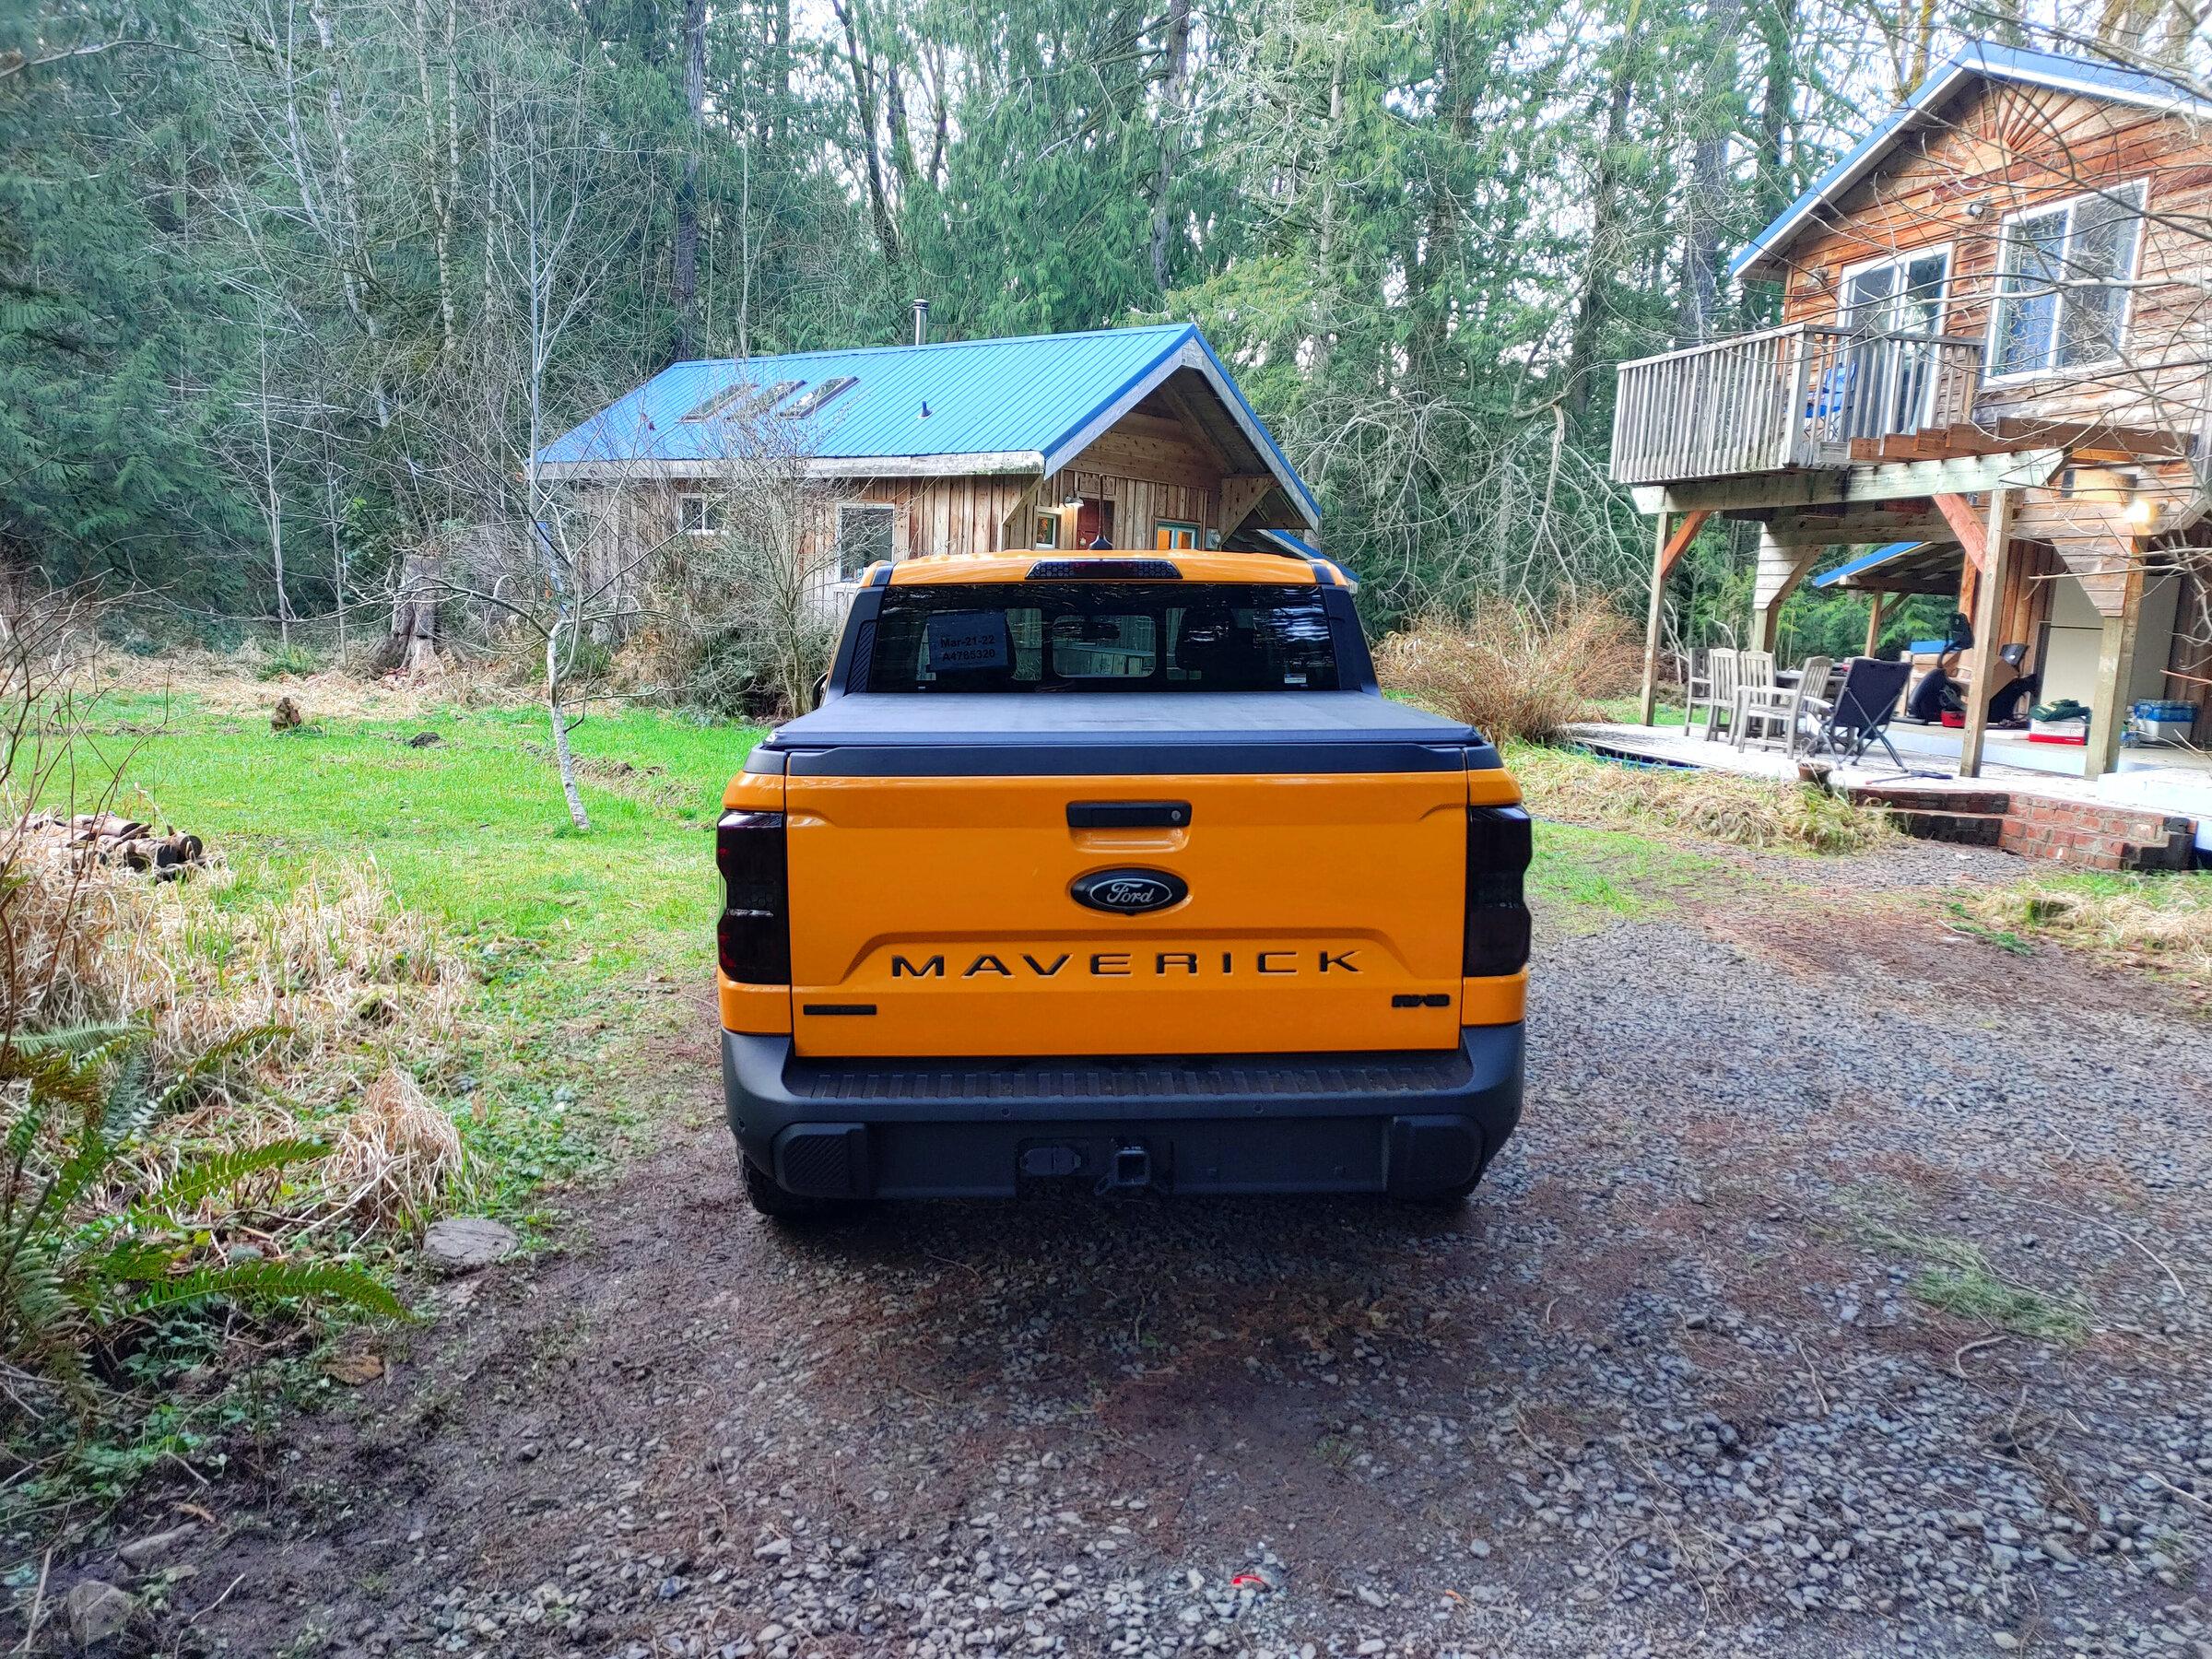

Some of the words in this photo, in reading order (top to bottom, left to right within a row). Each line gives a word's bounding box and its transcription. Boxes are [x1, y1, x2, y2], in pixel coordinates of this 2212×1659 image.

[940, 635, 995, 647] Mar-21-22
[1106, 882, 1155, 903] Ford
[891, 951, 1362, 979] MAVERICK
